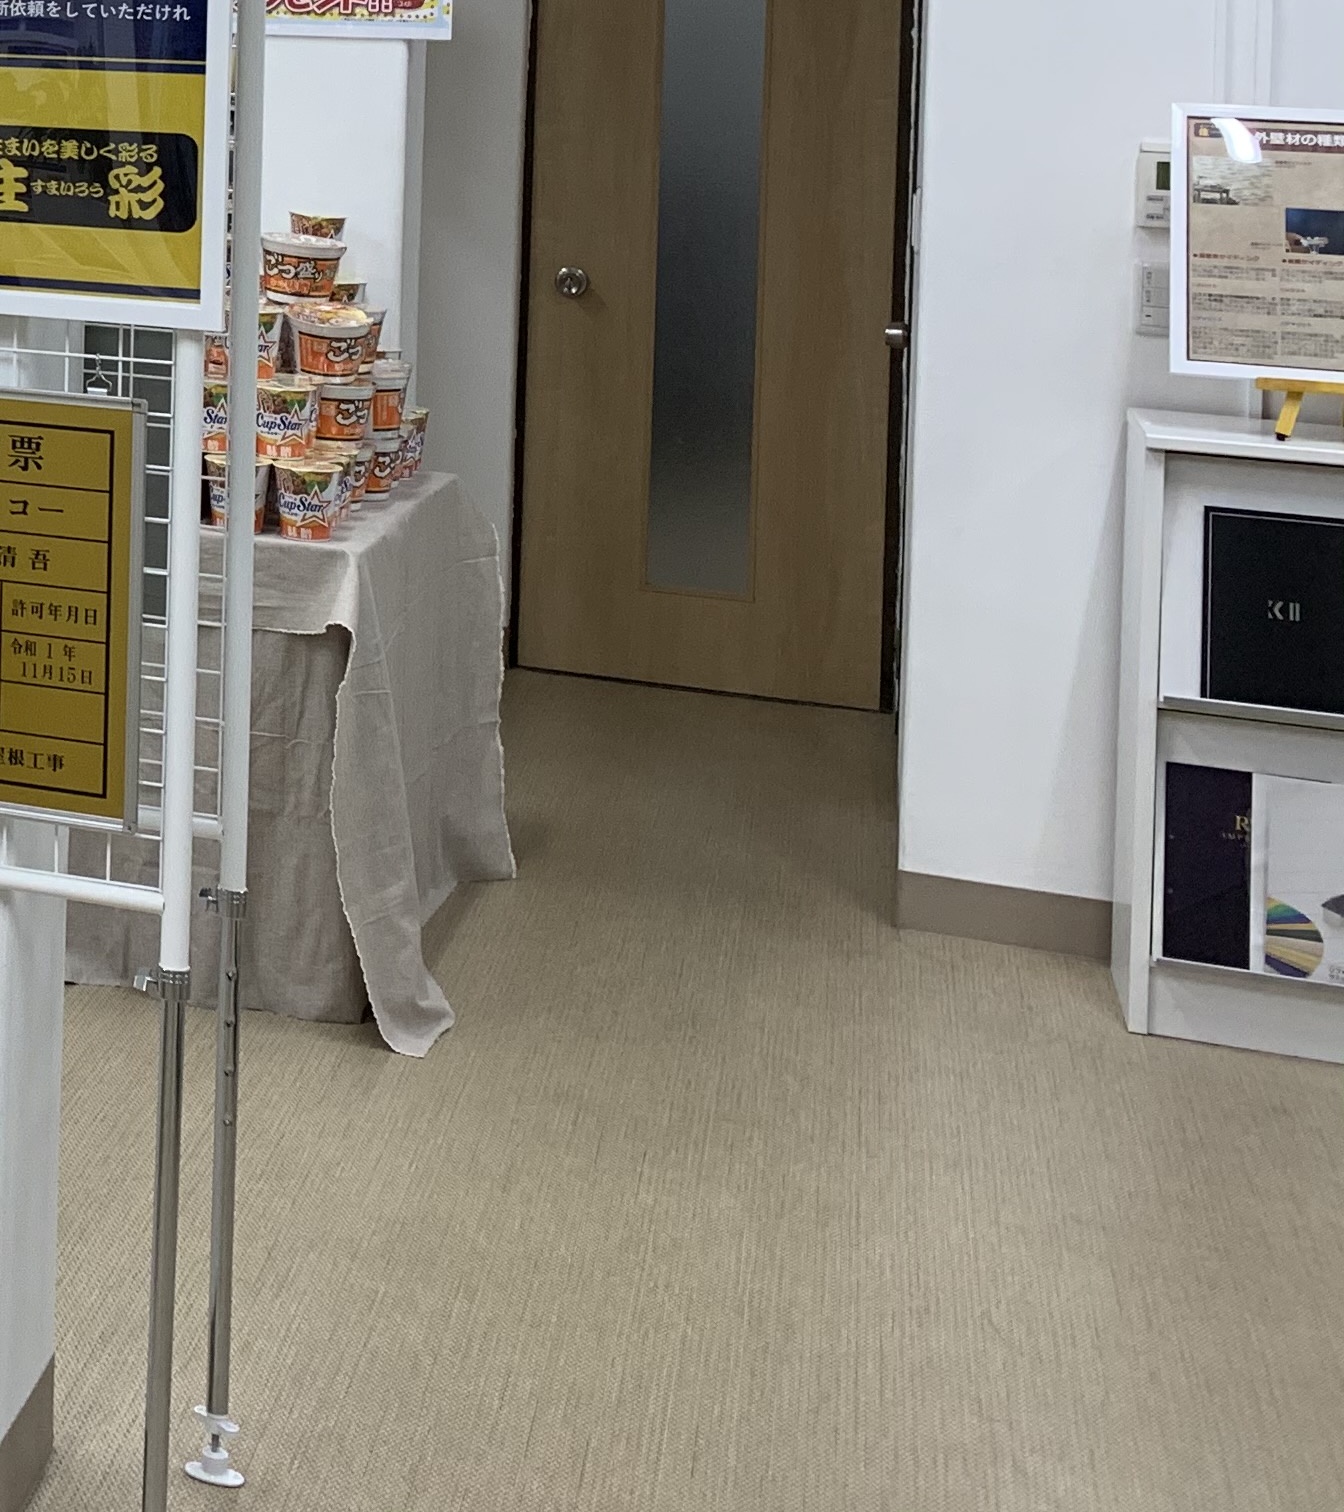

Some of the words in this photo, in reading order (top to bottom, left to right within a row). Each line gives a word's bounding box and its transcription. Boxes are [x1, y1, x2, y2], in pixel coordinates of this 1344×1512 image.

[29, 178, 104, 198] すまいろう
[12, 598, 98, 627] 許可年月日
[21, 660, 93, 686] 11月15日
